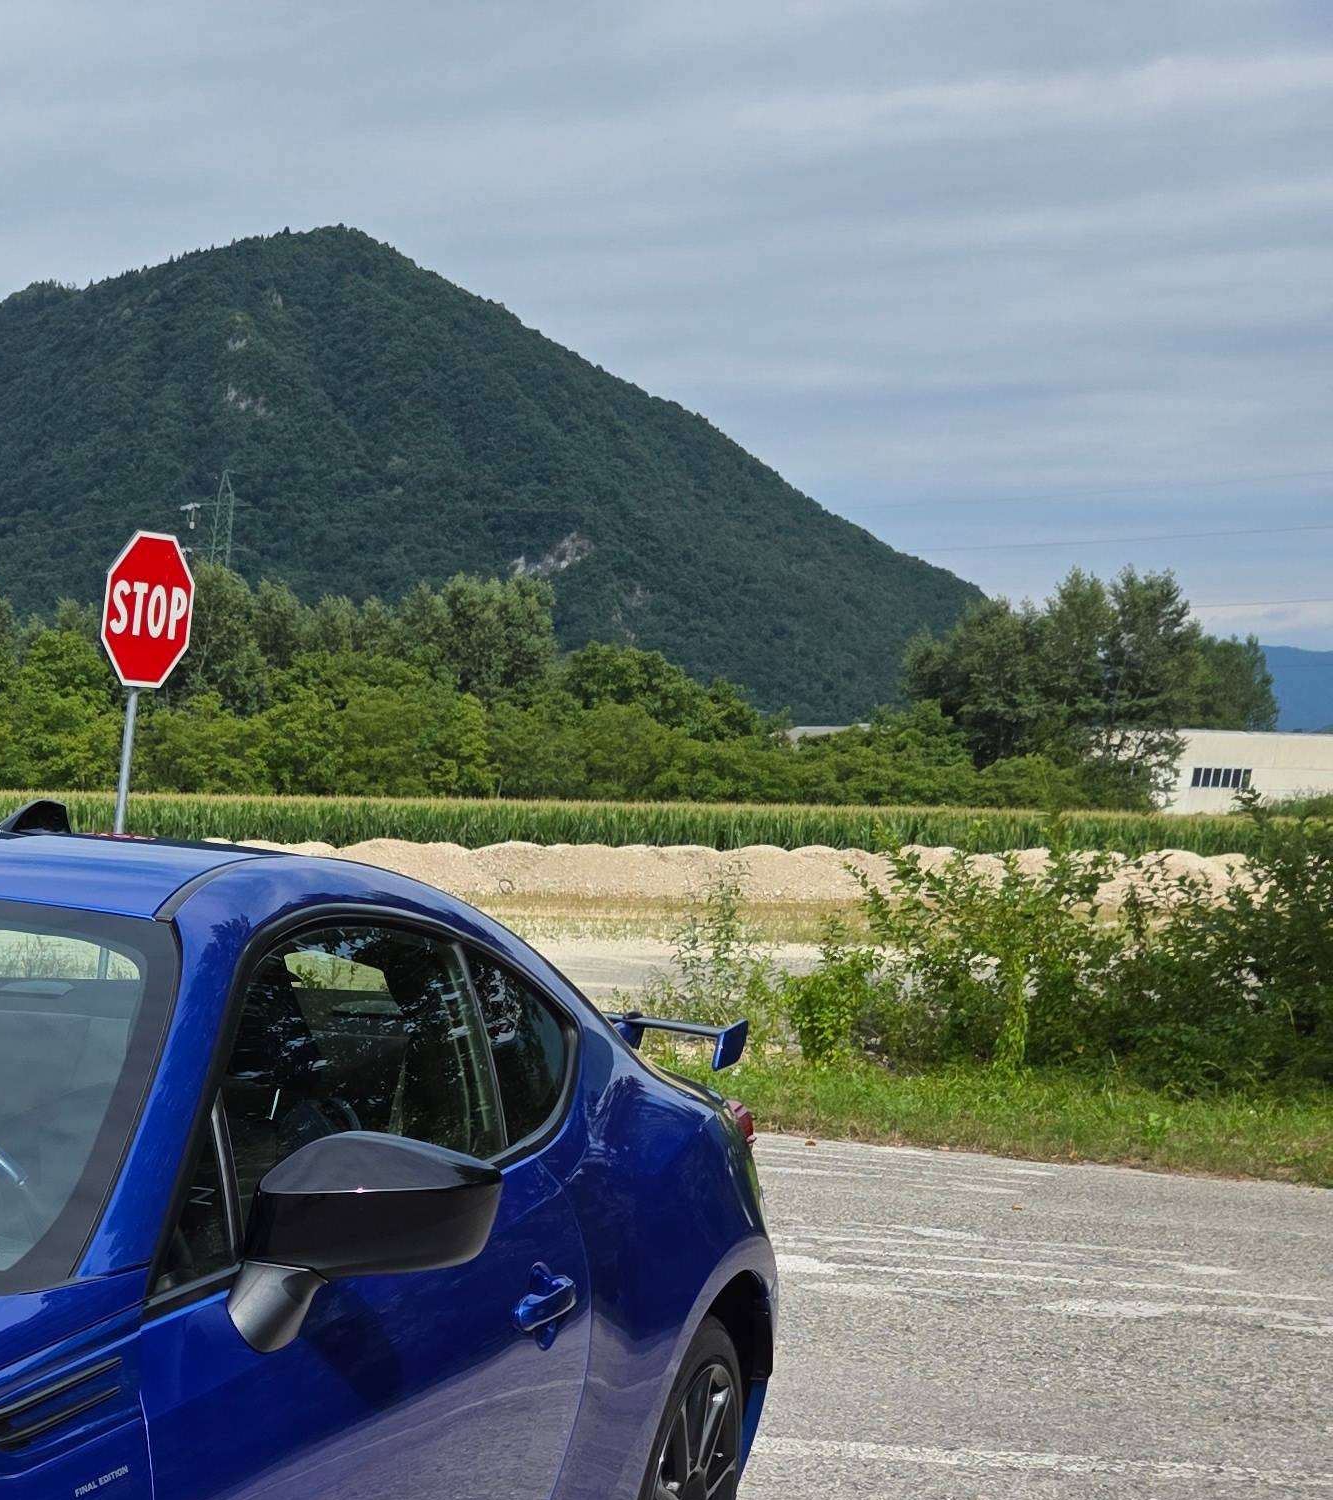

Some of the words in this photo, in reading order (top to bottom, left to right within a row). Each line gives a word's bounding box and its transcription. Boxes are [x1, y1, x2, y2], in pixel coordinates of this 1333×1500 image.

[109, 579, 188, 641] STOP
[74, 1480, 99, 1498] FINAL
[98, 1464, 129, 1486] EDITION
